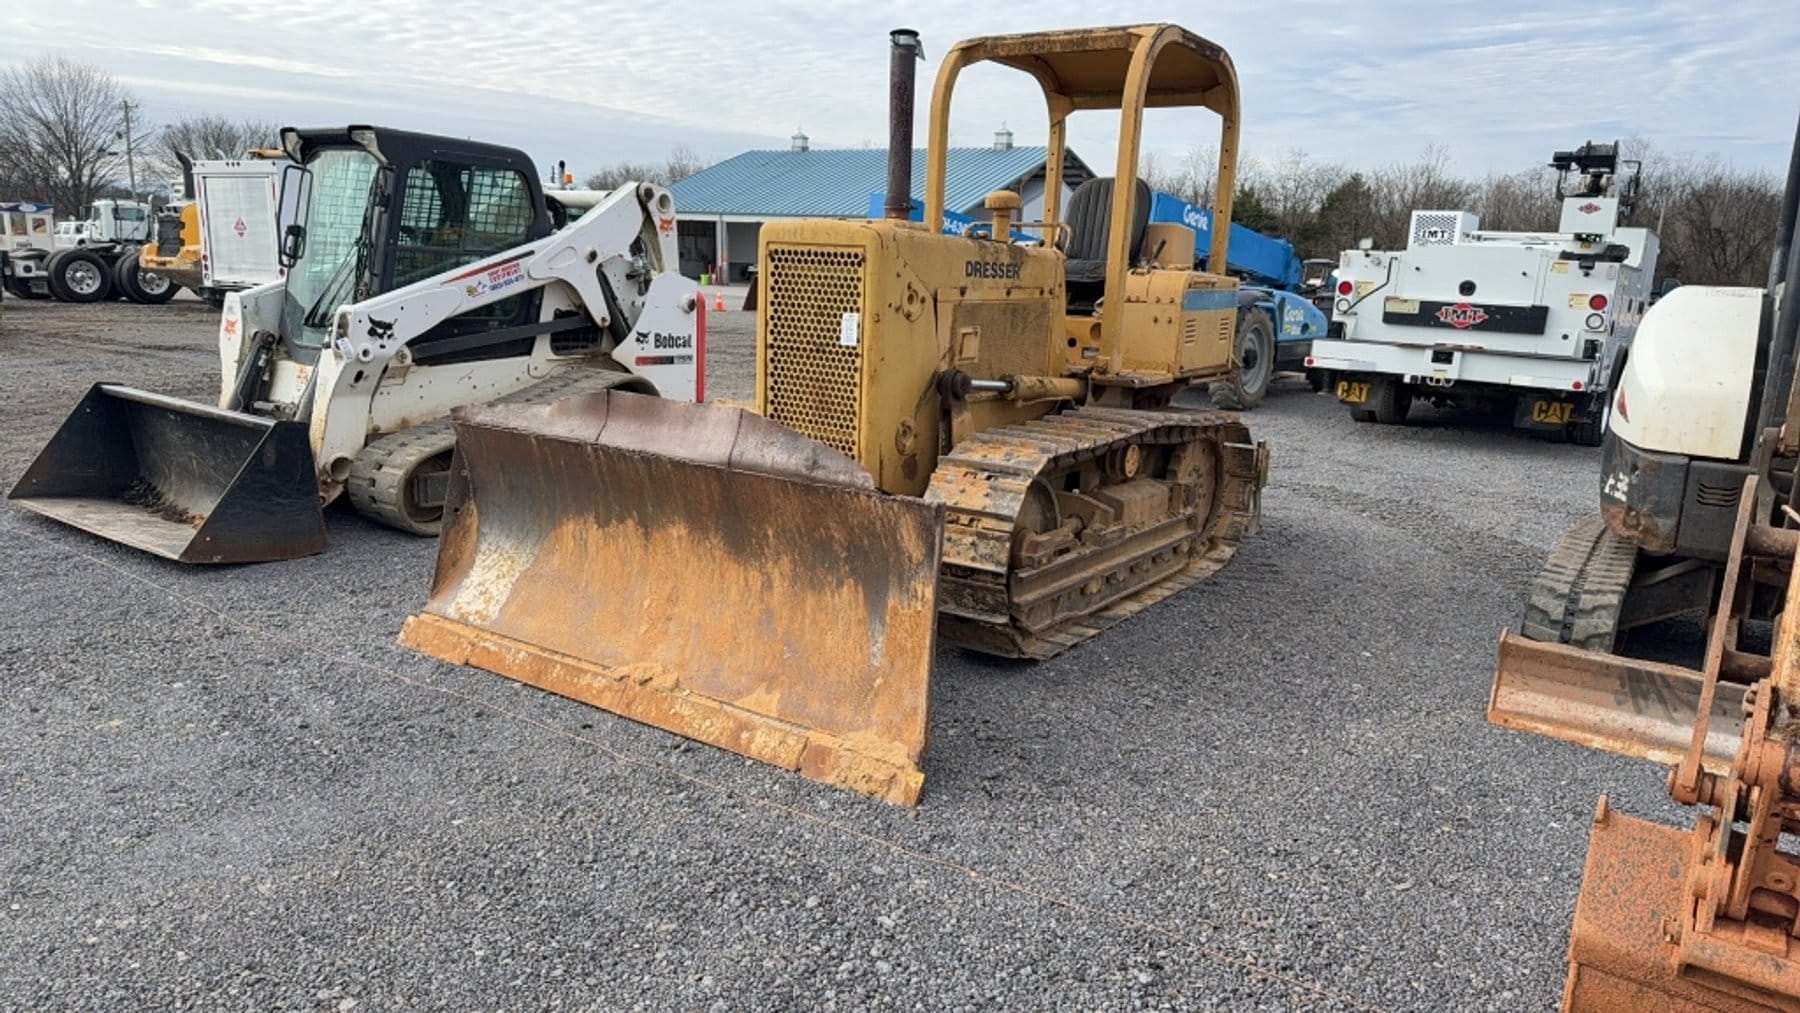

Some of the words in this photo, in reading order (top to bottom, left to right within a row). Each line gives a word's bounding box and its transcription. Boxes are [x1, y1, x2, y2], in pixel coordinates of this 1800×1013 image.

[1183, 204, 1208, 231] Genie
[1422, 230, 1448, 238] IMT
[965, 261, 1020, 279] DRESSER
[1440, 305, 1484, 325] IMT
[654, 332, 692, 349] Bobcat
[1337, 381, 1370, 403] CAT
[1533, 400, 1574, 424] CAT
